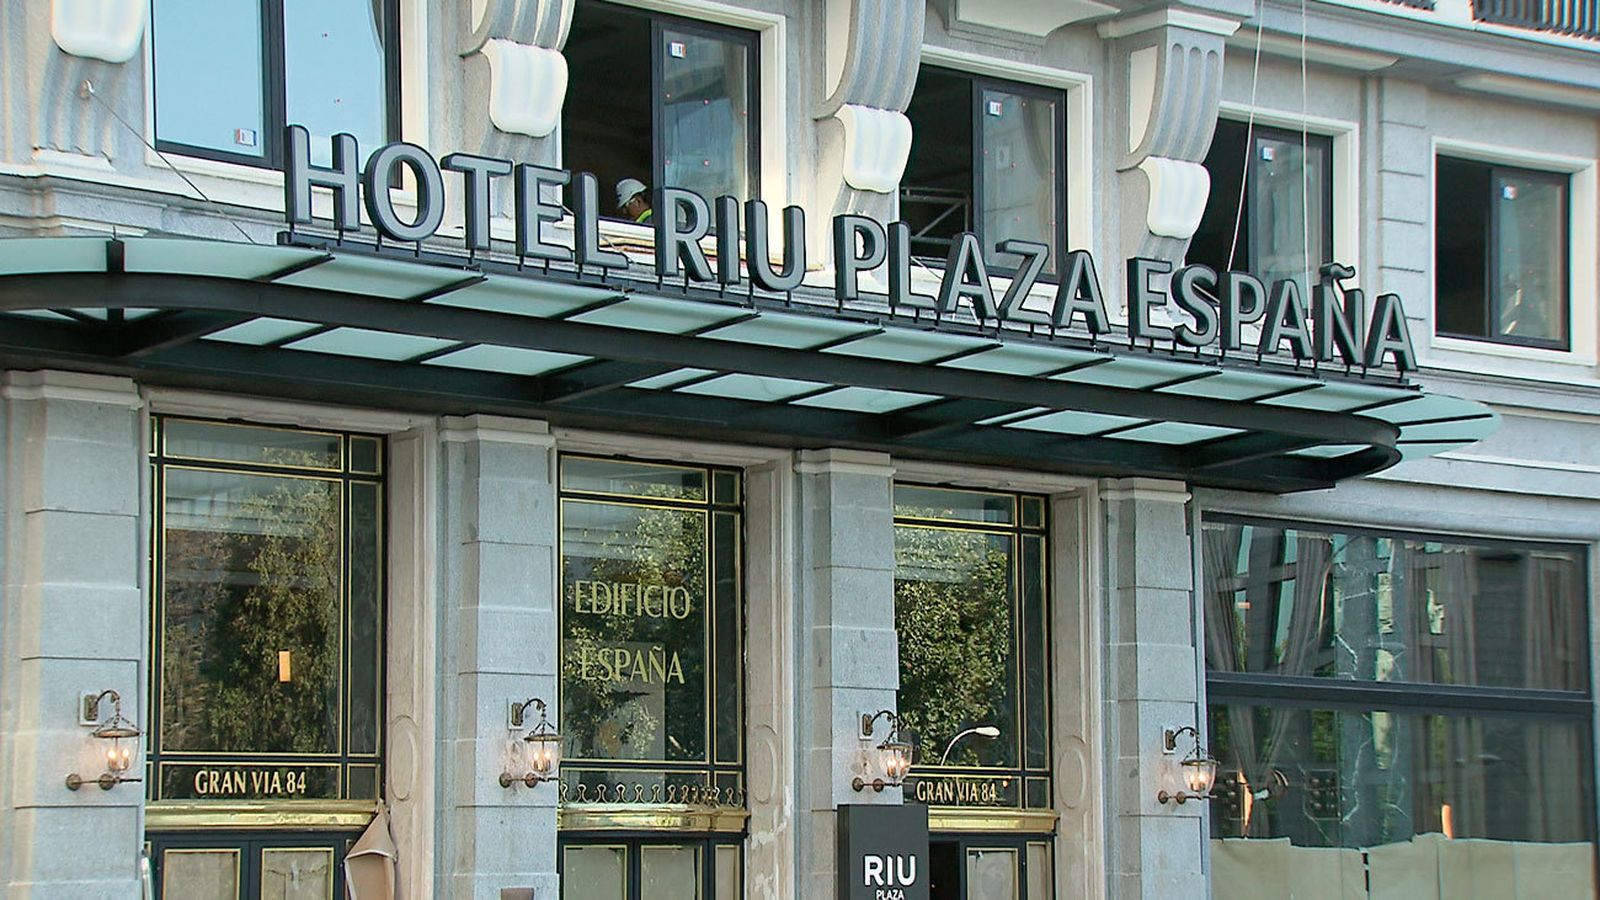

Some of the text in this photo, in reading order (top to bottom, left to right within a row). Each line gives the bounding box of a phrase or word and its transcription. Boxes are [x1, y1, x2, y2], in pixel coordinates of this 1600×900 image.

[285, 124, 1417, 371] HOTEL RIU PLAZA ESPAÑA
[575, 579, 691, 619] EDIFICIO
[580, 645, 685, 684] ESPAÑA
[195, 770, 306, 794] GRAN VIA 84
[916, 780, 997, 803] GRAN VIA 84
[864, 854, 917, 886] RIU
[876, 889, 905, 900] PLAZA
